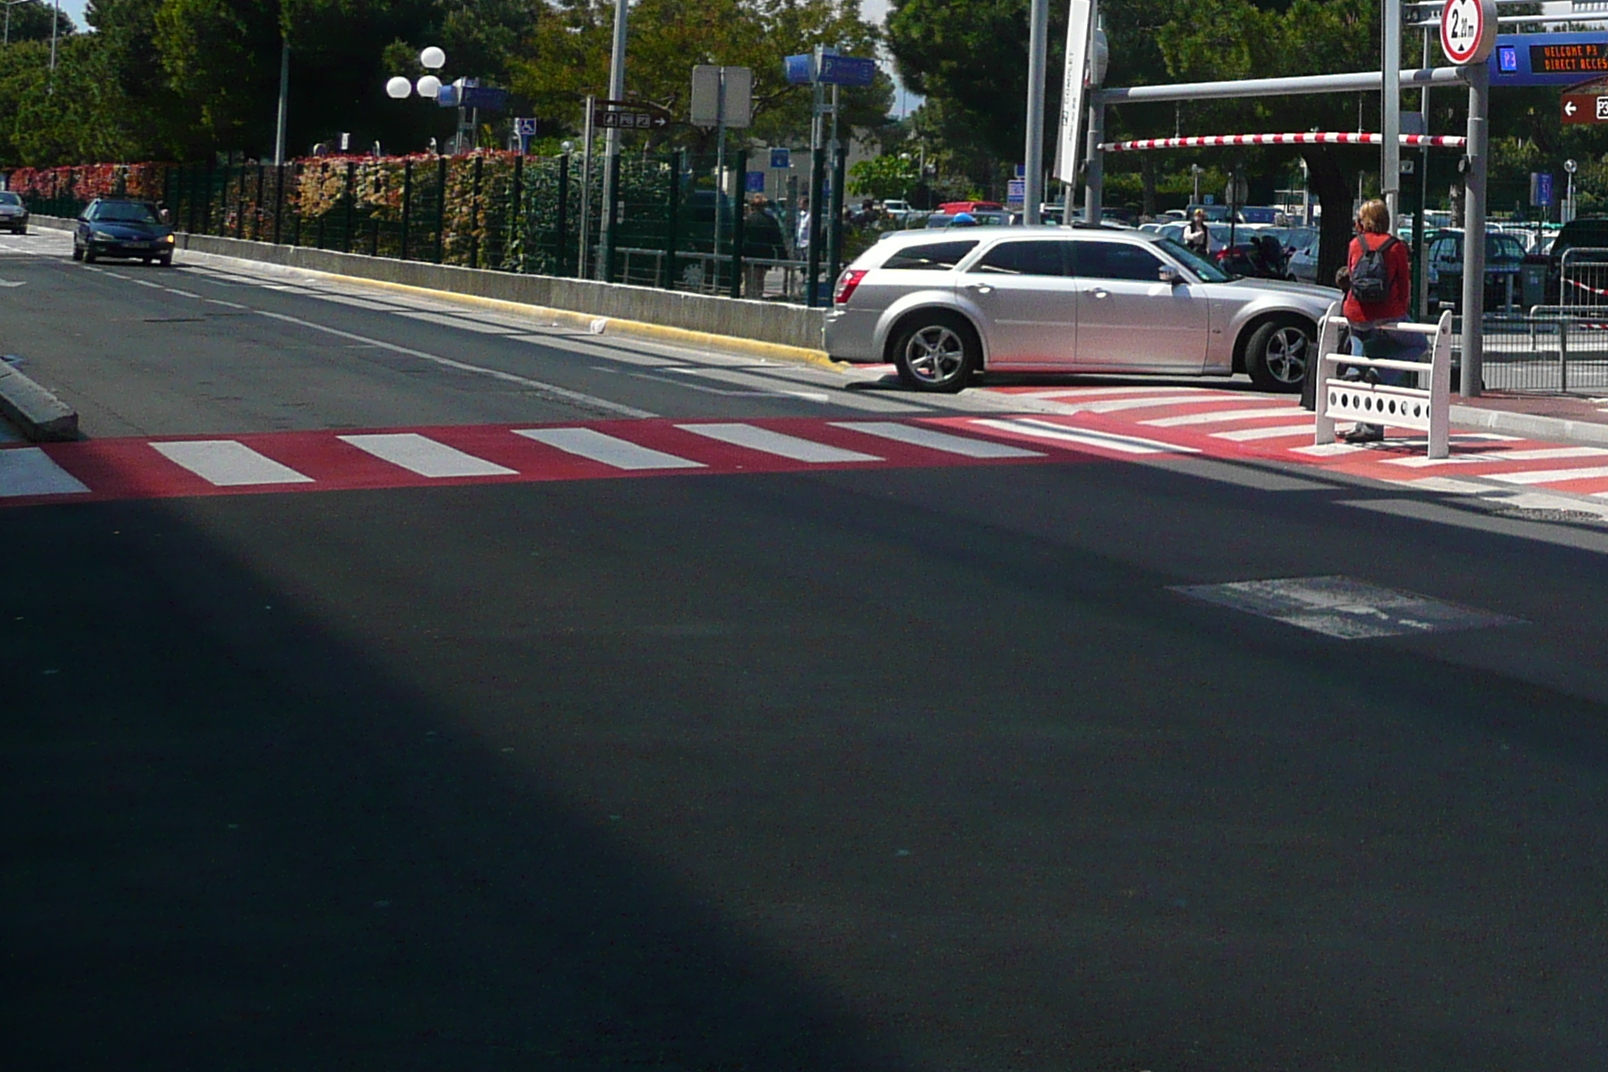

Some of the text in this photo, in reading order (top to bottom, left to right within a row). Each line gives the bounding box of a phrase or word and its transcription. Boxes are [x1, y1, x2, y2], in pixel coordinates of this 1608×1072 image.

[1544, 44, 1599, 57] WELCOME P3
[1504, 51, 1516, 67] P3
[1544, 58, 1577, 71] DIRECT
